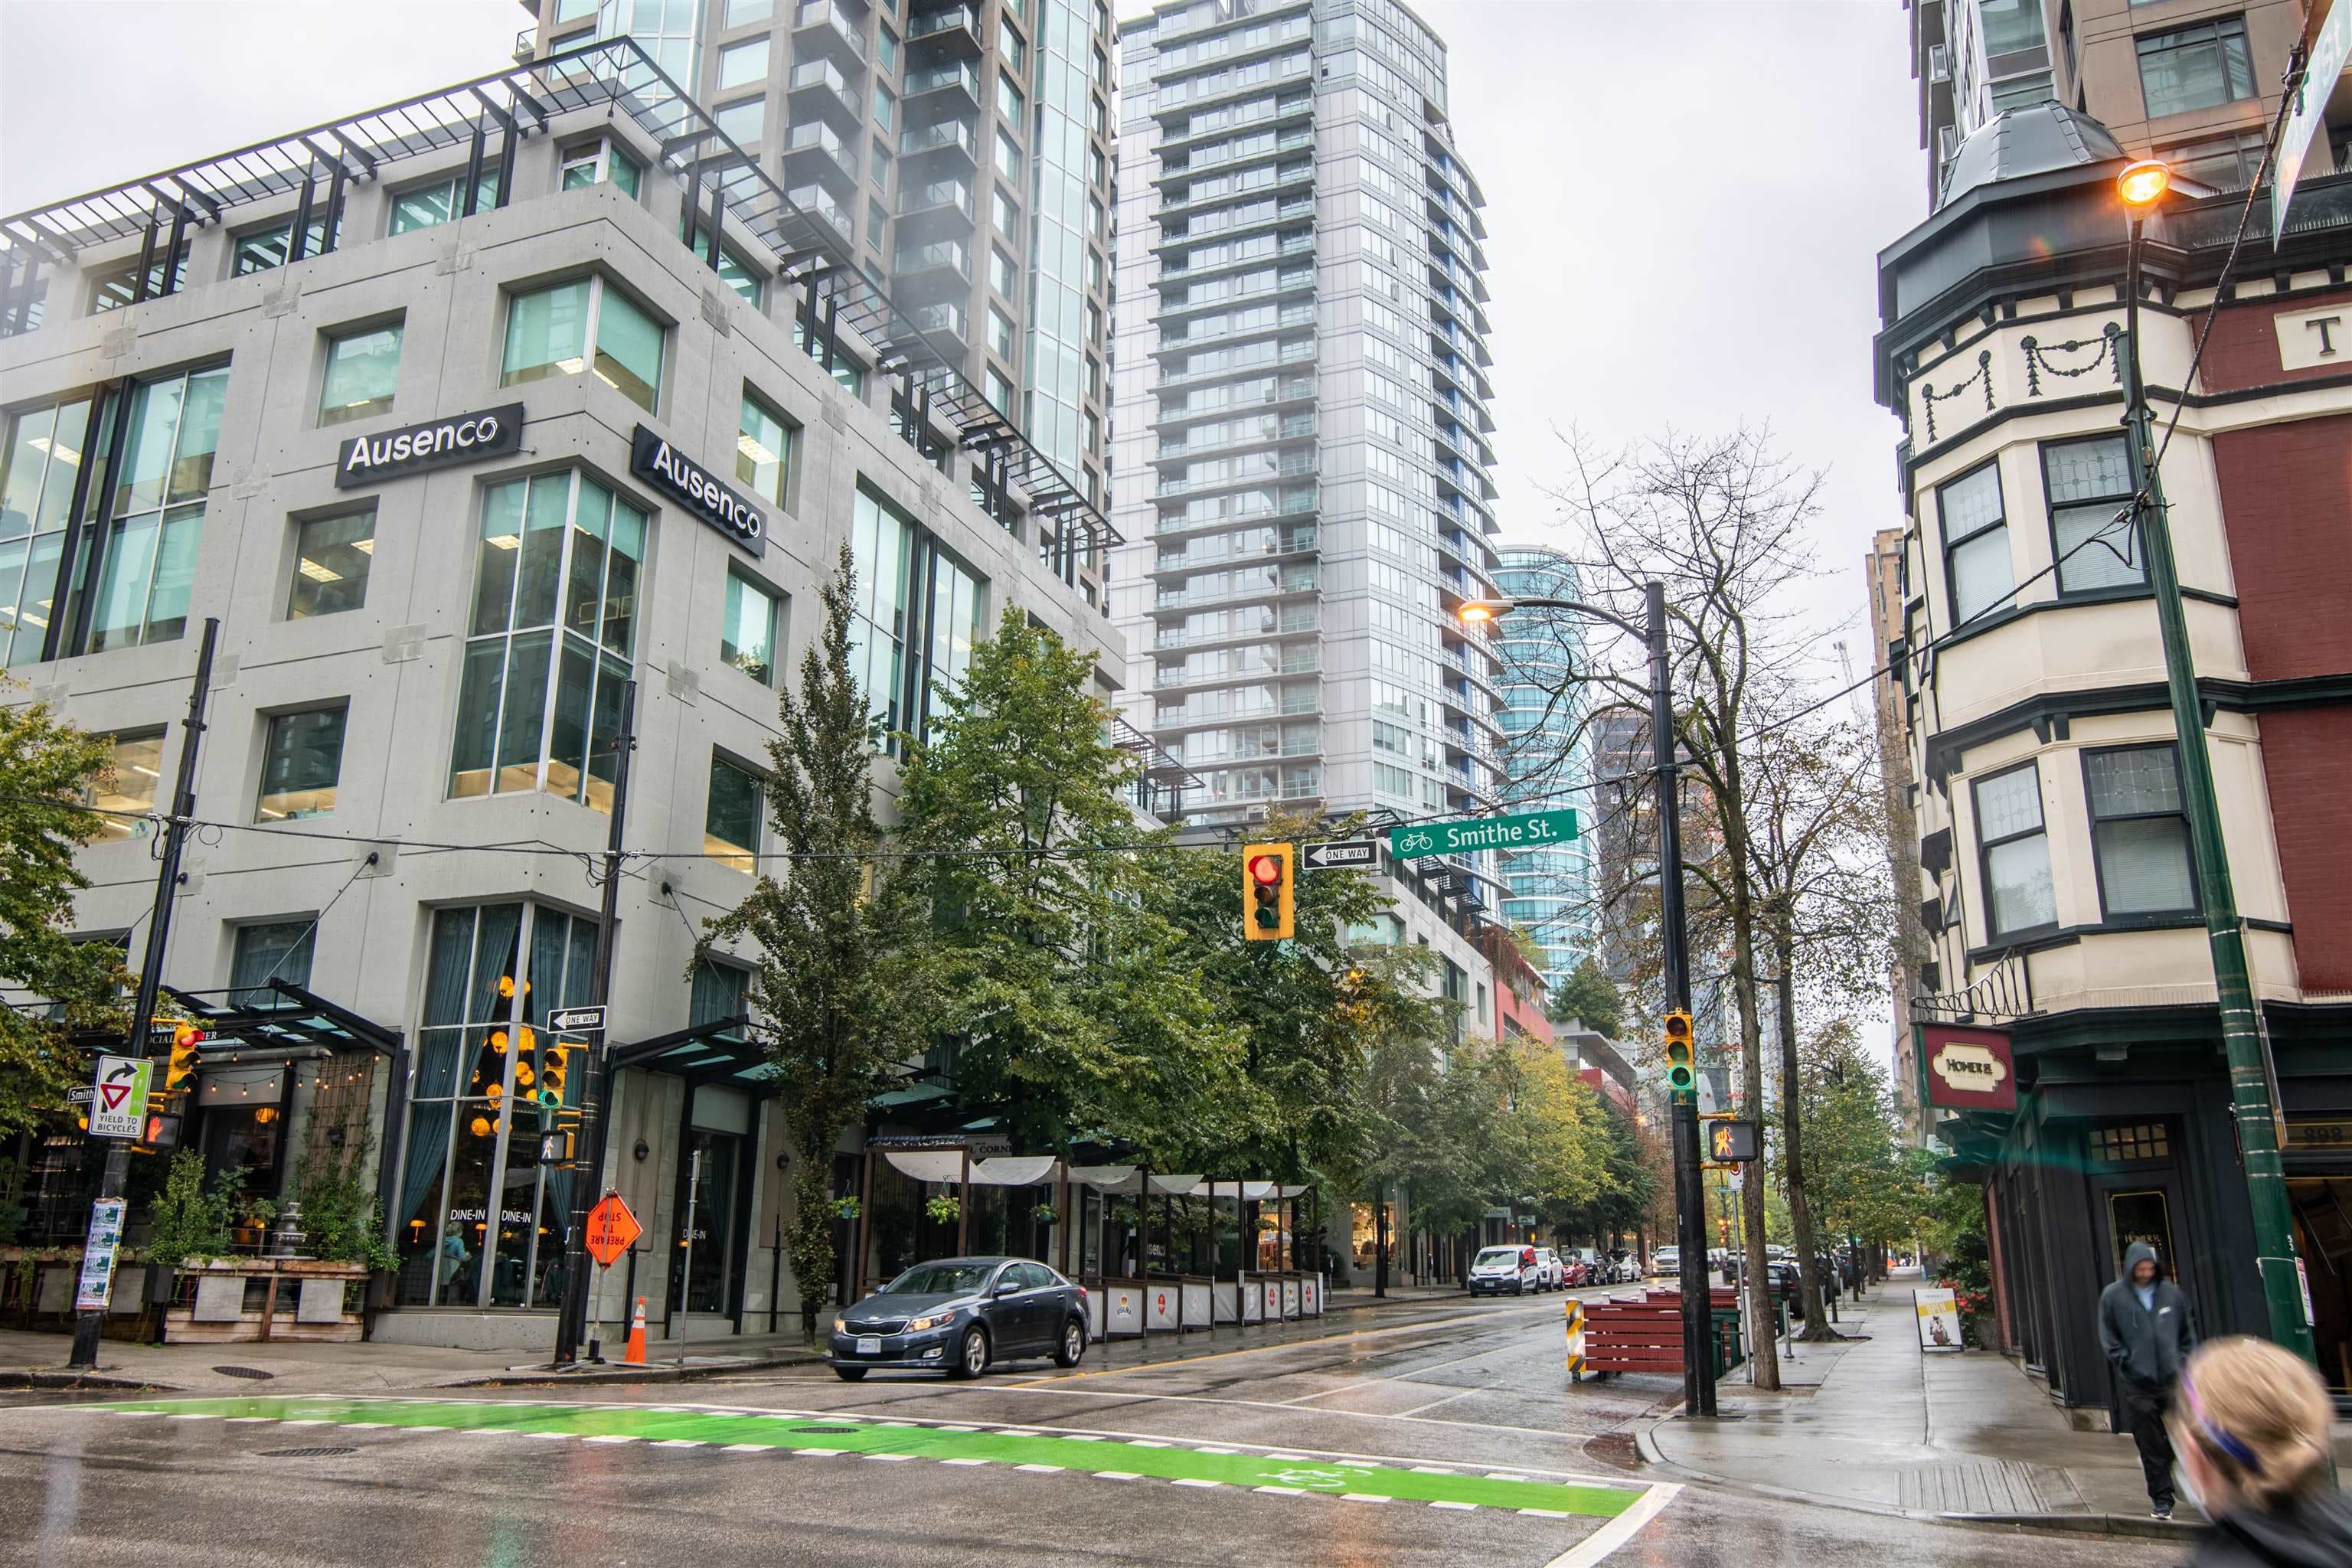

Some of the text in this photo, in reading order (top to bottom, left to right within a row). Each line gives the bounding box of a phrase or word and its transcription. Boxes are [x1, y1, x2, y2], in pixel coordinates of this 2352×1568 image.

[346, 416, 498, 471] Ausenco
[652, 441, 762, 539] Ausenco
[1446, 818, 1558, 848] Smithe St.
[1325, 848, 1369, 860] ONE WAY
[565, 1014, 598, 1024] ONE WAY
[1946, 1058, 1983, 1073] HOMER
[70, 1090, 94, 1100] Smith
[100, 1115, 123, 1123] YIELD
[97, 1124, 136, 1133] BICYCLES
[450, 1209, 485, 1220] DINE-IN
[501, 1210, 532, 1223] DINE-IN
[683, 1228, 707, 1240] DNE-IN
